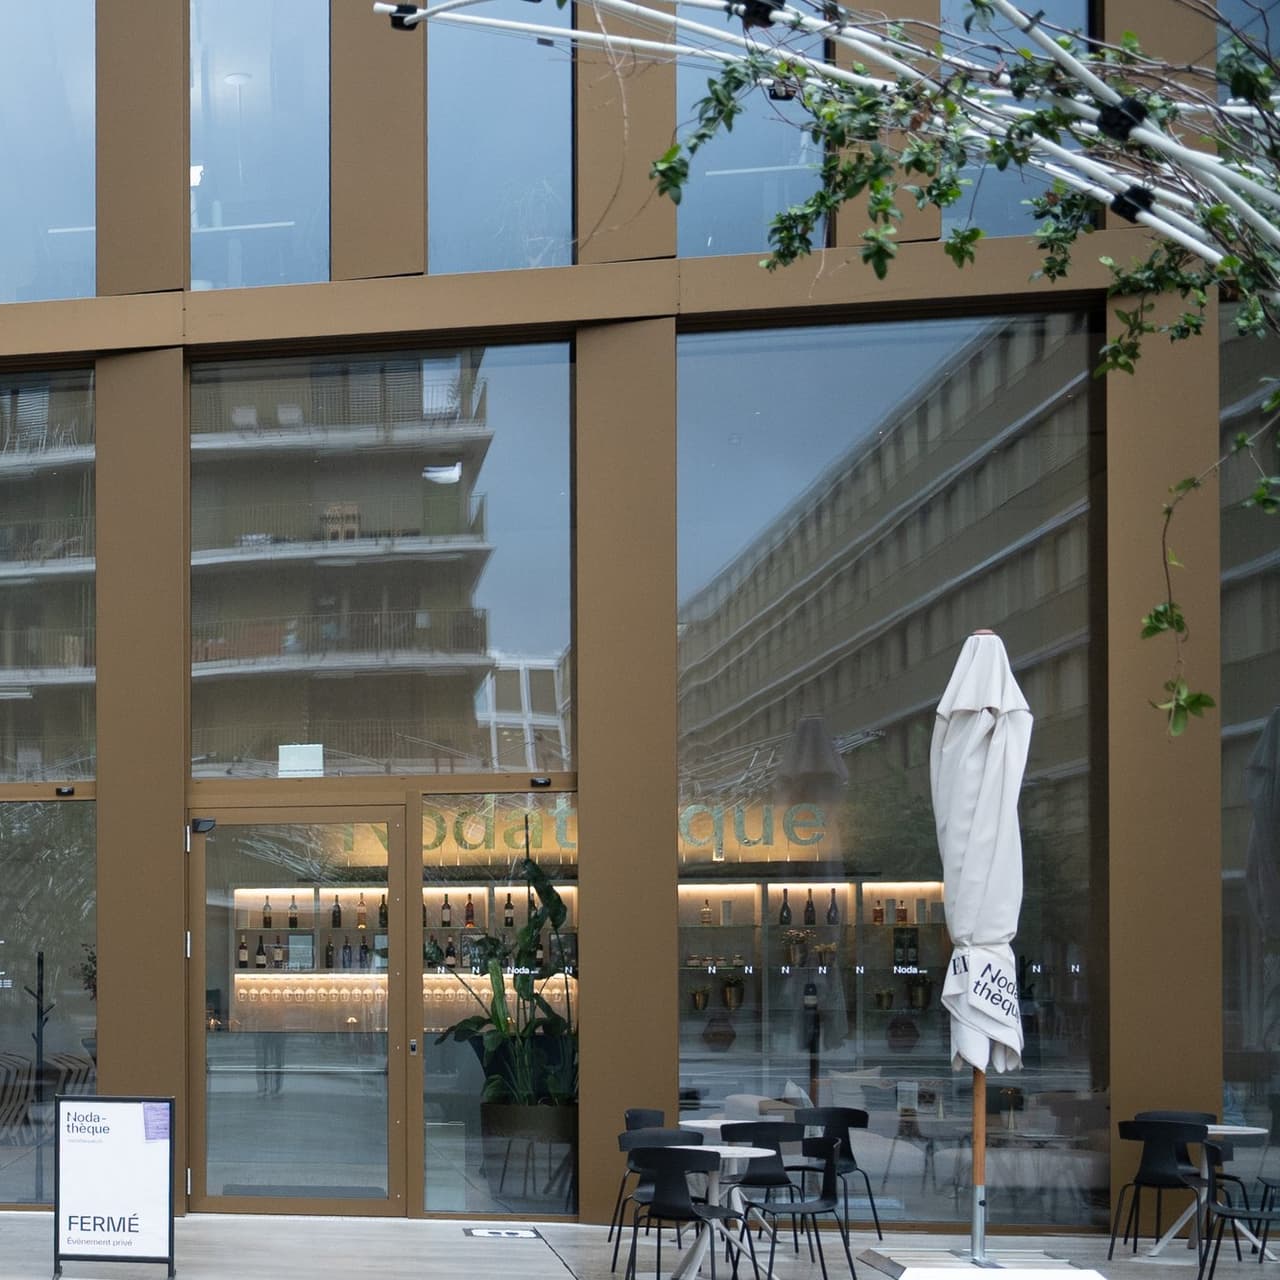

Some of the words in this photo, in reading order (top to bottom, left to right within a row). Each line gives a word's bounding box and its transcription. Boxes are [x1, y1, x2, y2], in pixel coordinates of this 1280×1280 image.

[507, 966, 530, 975] Noda
[893, 965, 919, 974] Noda
[66, 1111, 107, 1123] Noda-
[66, 1123, 110, 1136] thèque
[68, 1212, 139, 1233] FERMÉ
